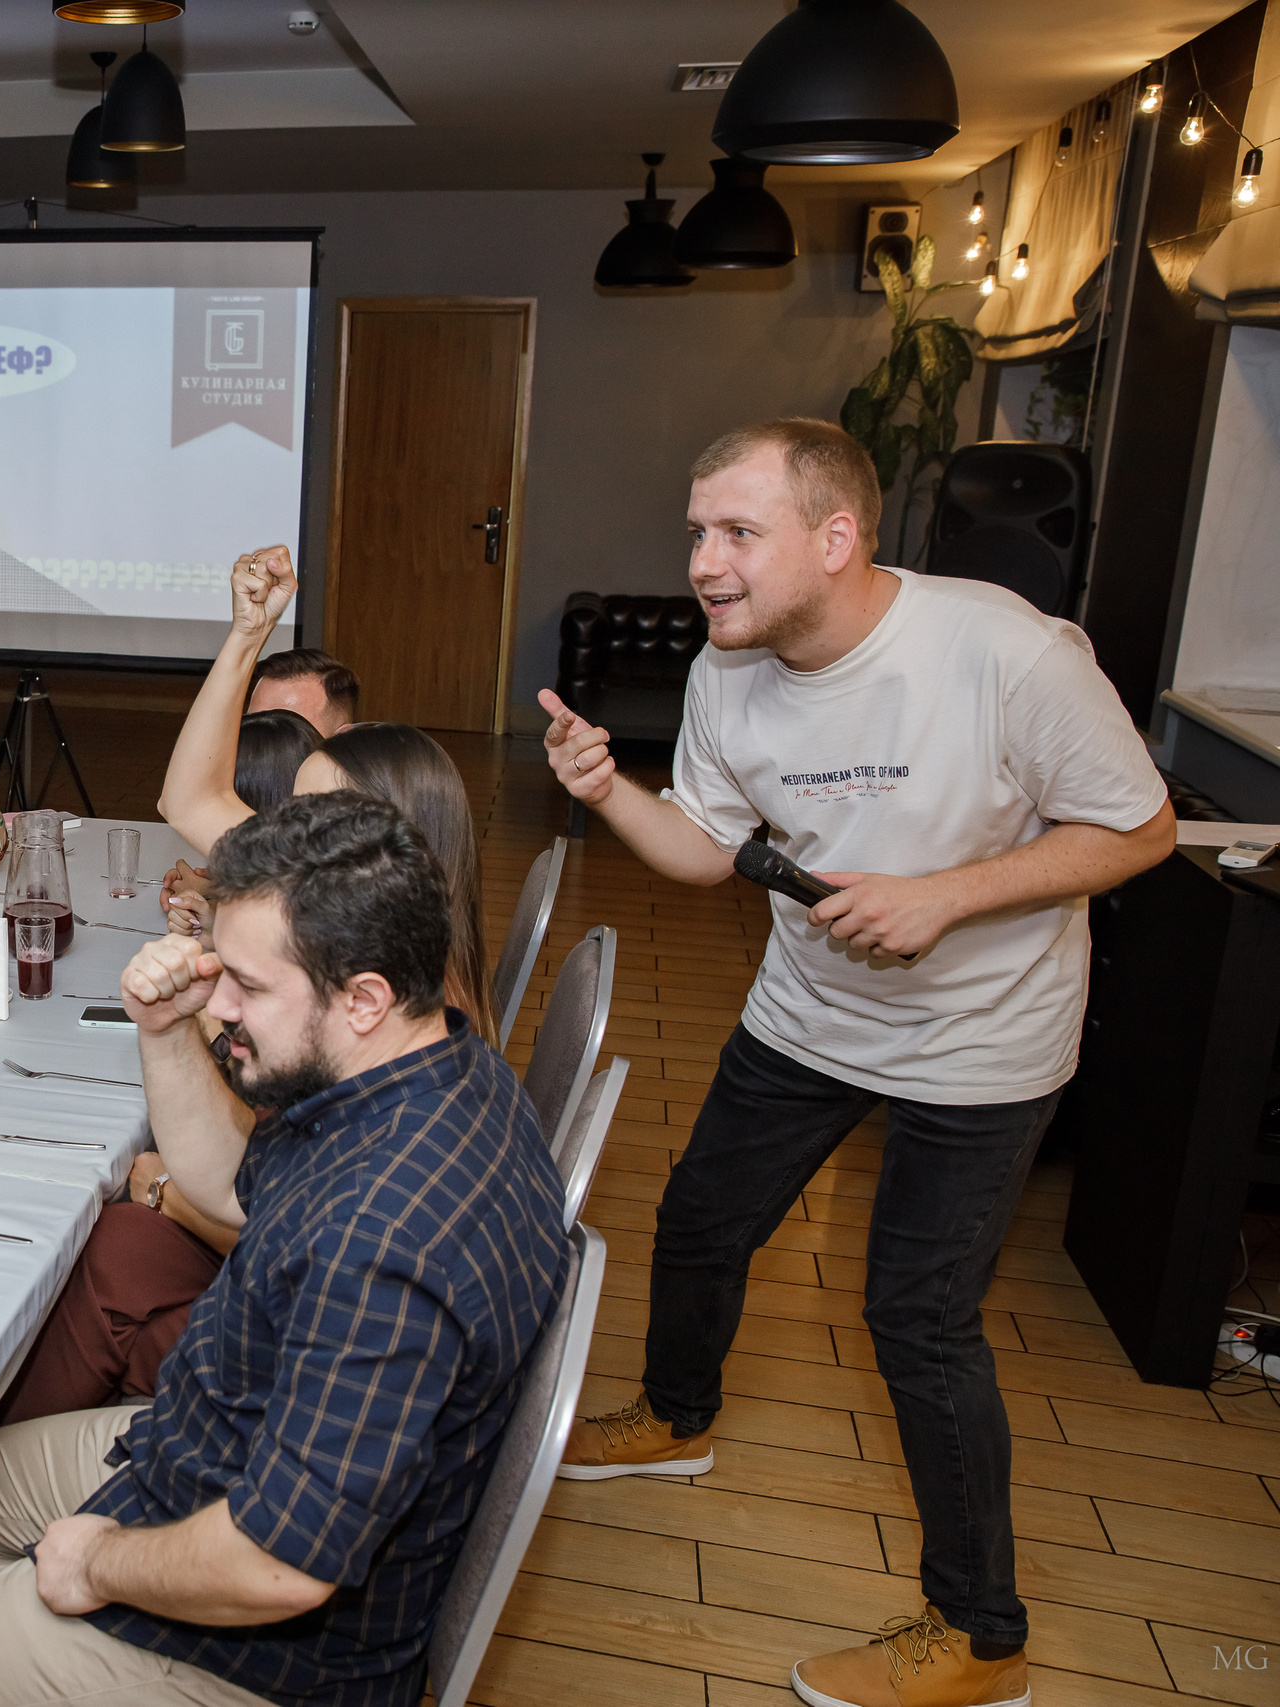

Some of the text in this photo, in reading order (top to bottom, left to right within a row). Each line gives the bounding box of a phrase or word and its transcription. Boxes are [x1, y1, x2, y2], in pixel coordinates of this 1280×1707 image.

[180, 376, 286, 390] КУЛИНАРНАЯ
[201, 393, 263, 406] СТУДИЯ
[780, 769, 852, 786] MEDITERRANEAN
[853, 765, 876, 778] STATE
[878, 766, 887, 778] OF
